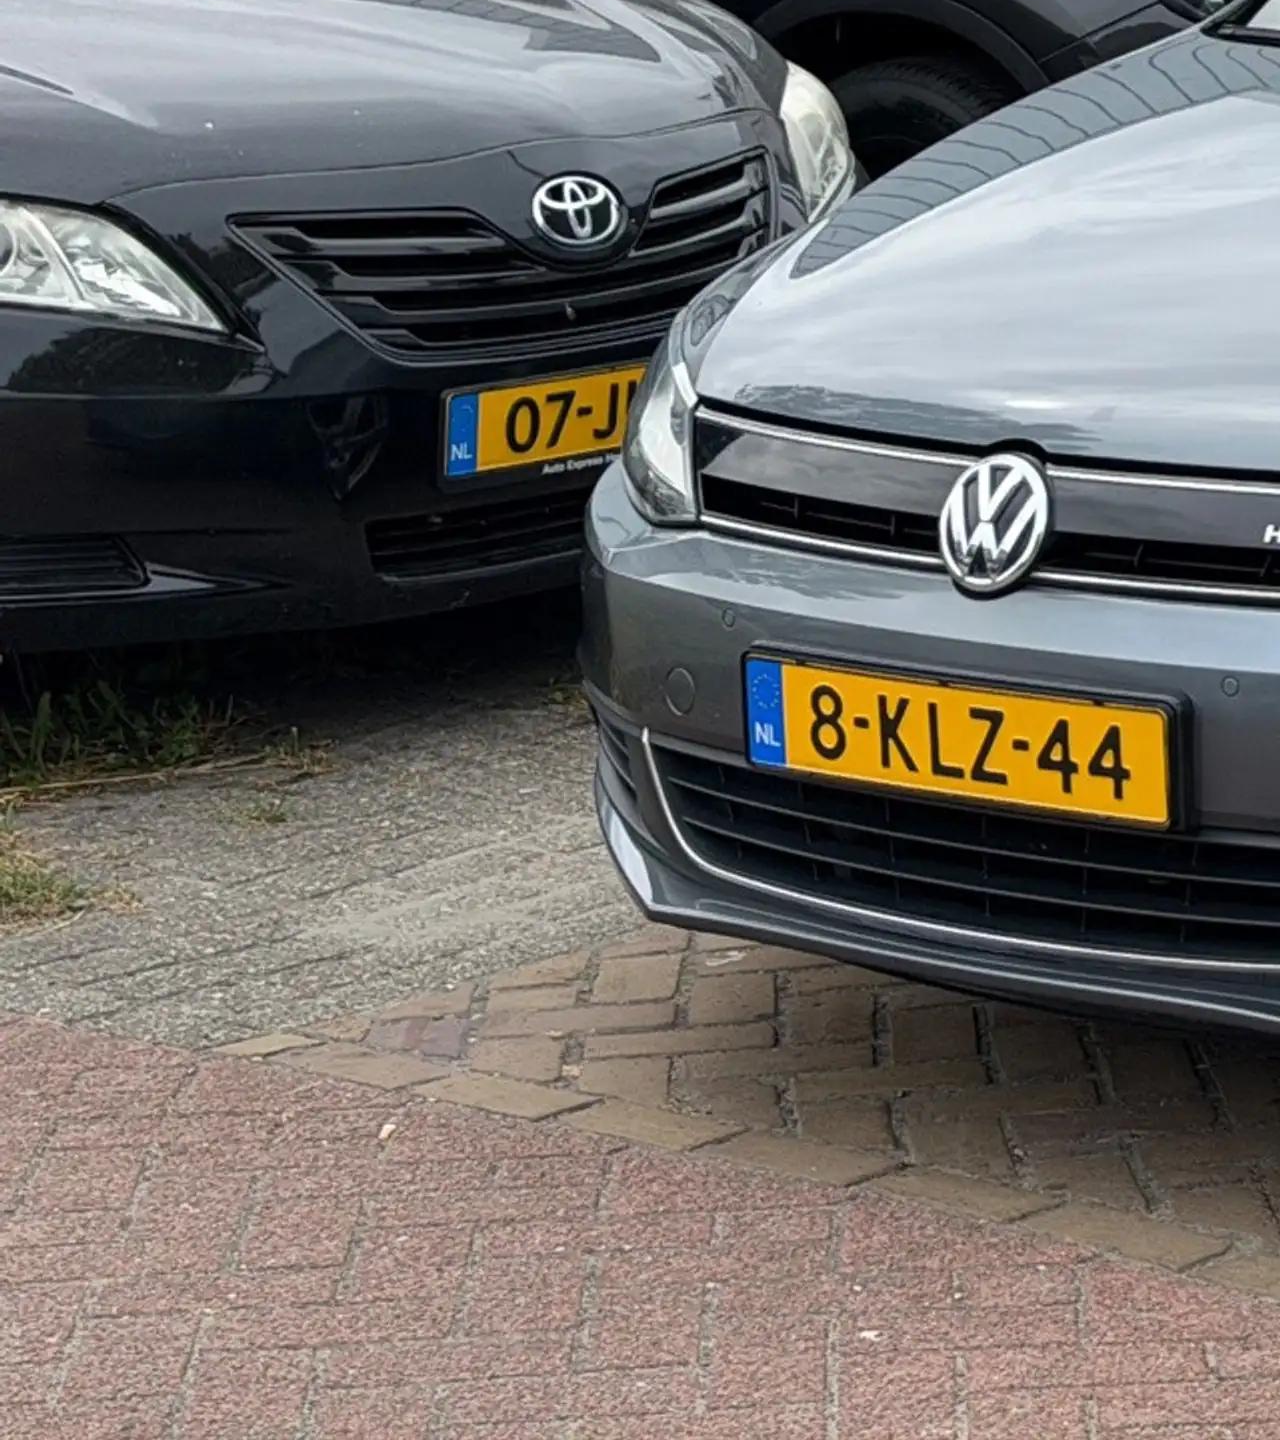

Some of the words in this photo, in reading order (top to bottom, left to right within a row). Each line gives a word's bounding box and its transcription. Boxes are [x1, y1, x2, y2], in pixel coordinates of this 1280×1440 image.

[451, 443, 473, 460] NL
[754, 721, 782, 747] NL
[808, 684, 1132, 801] 8-KLZ-44
